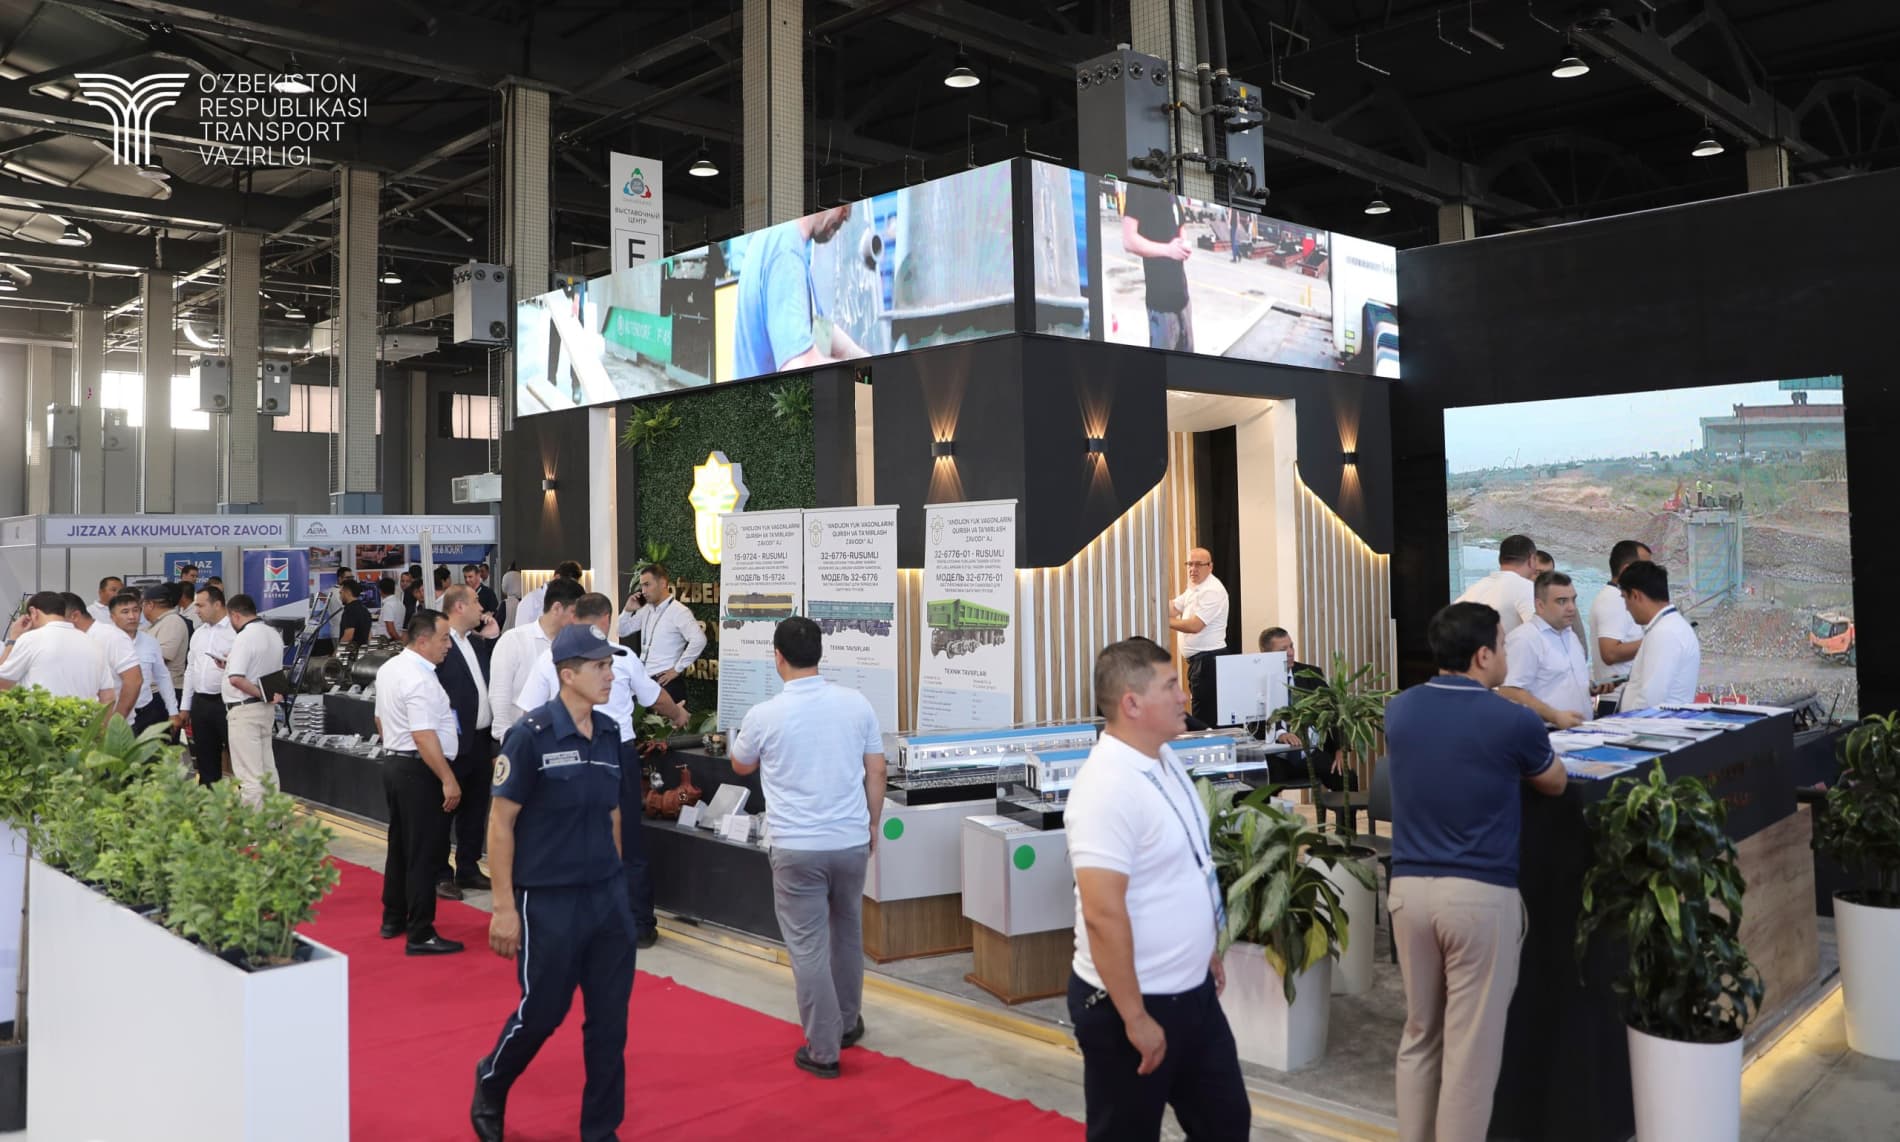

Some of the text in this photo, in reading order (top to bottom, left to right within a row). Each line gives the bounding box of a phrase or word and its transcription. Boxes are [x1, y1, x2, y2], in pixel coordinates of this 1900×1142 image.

[67, 525, 282, 537] JIZZAX AKKUMULYATOR ZAVODI
[342, 524, 370, 535] ABM
[734, 553, 757, 561] 15-9724
[761, 551, 788, 560] RUSUMLI
[976, 549, 1005, 558] RUSUMLI
[195, 561, 213, 569] JAZ
[762, 573, 786, 581] 15-9724
[821, 573, 879, 582] МОДЕЛЬ 32-6776
[936, 573, 1003, 582] МОДЕЛЬ 32-6776-01
[264, 582, 290, 592] JAZ
